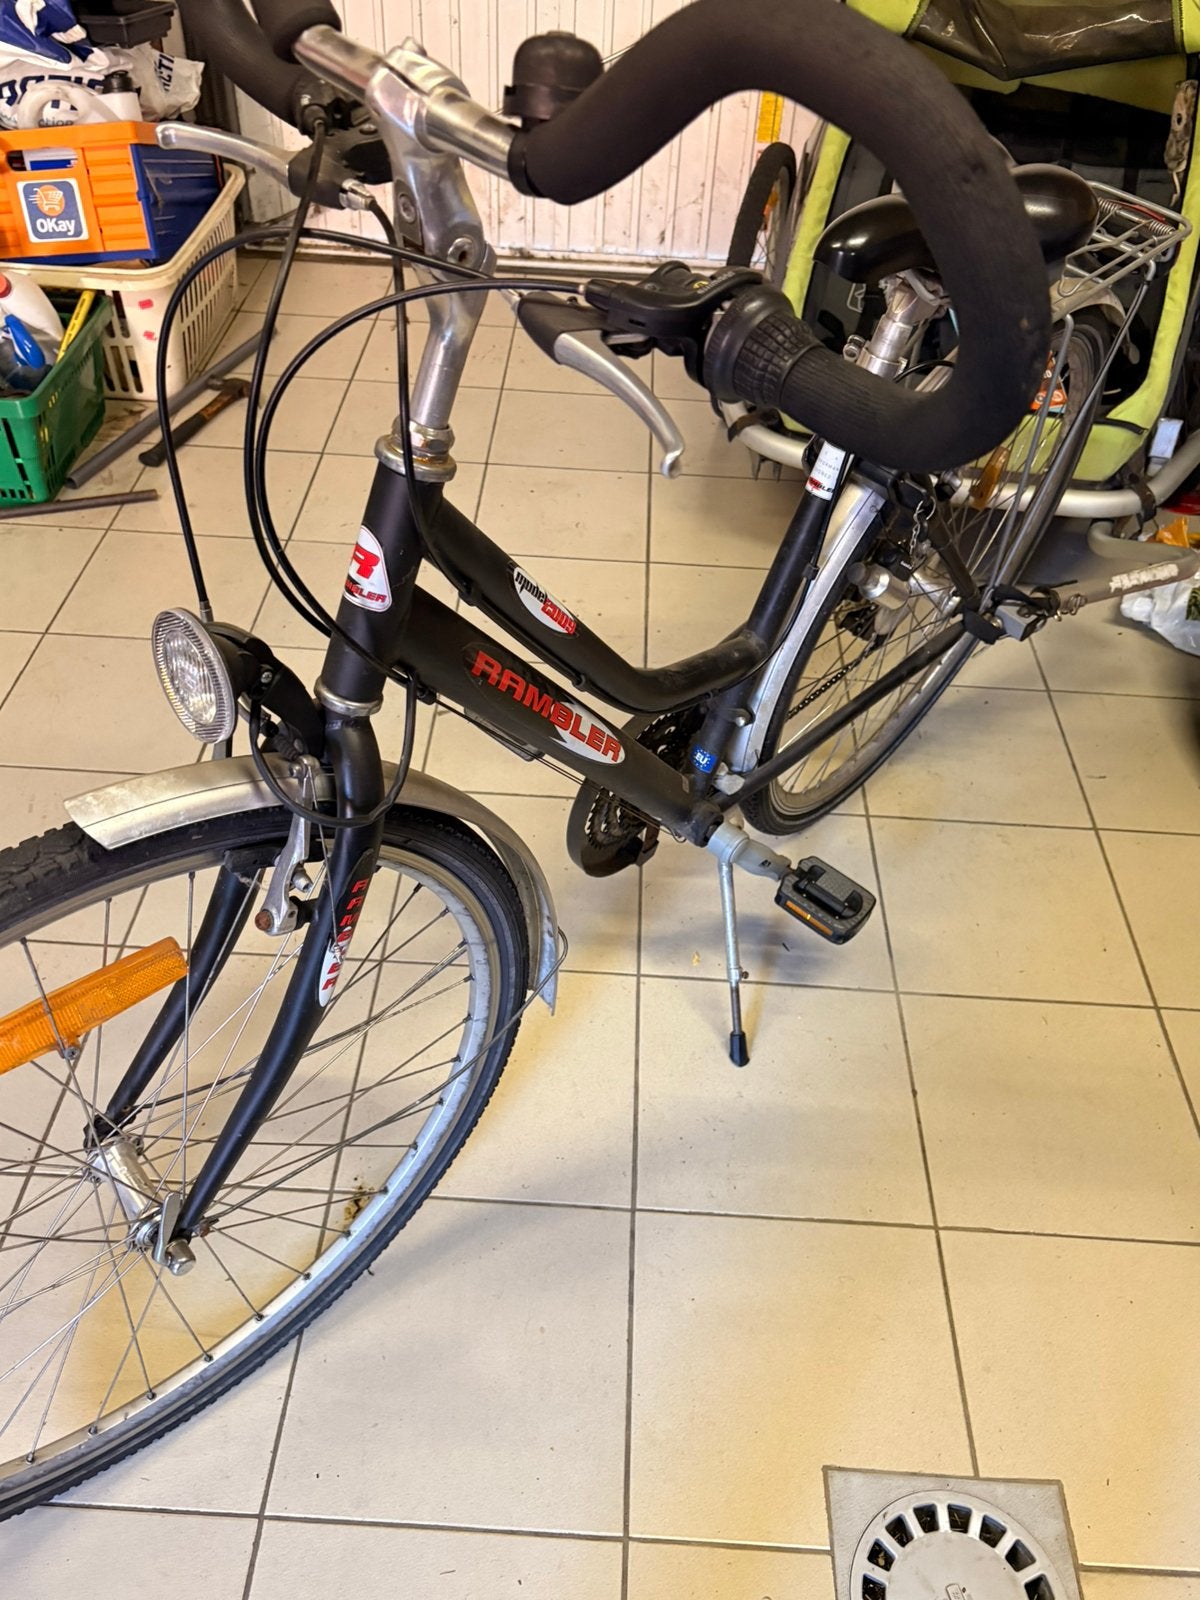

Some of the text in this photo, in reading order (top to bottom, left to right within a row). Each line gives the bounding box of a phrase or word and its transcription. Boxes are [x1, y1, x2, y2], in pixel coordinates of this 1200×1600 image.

[36, 217, 76, 236] OKay
[352, 543, 381, 579] R
[470, 649, 622, 763] RAMBLER
